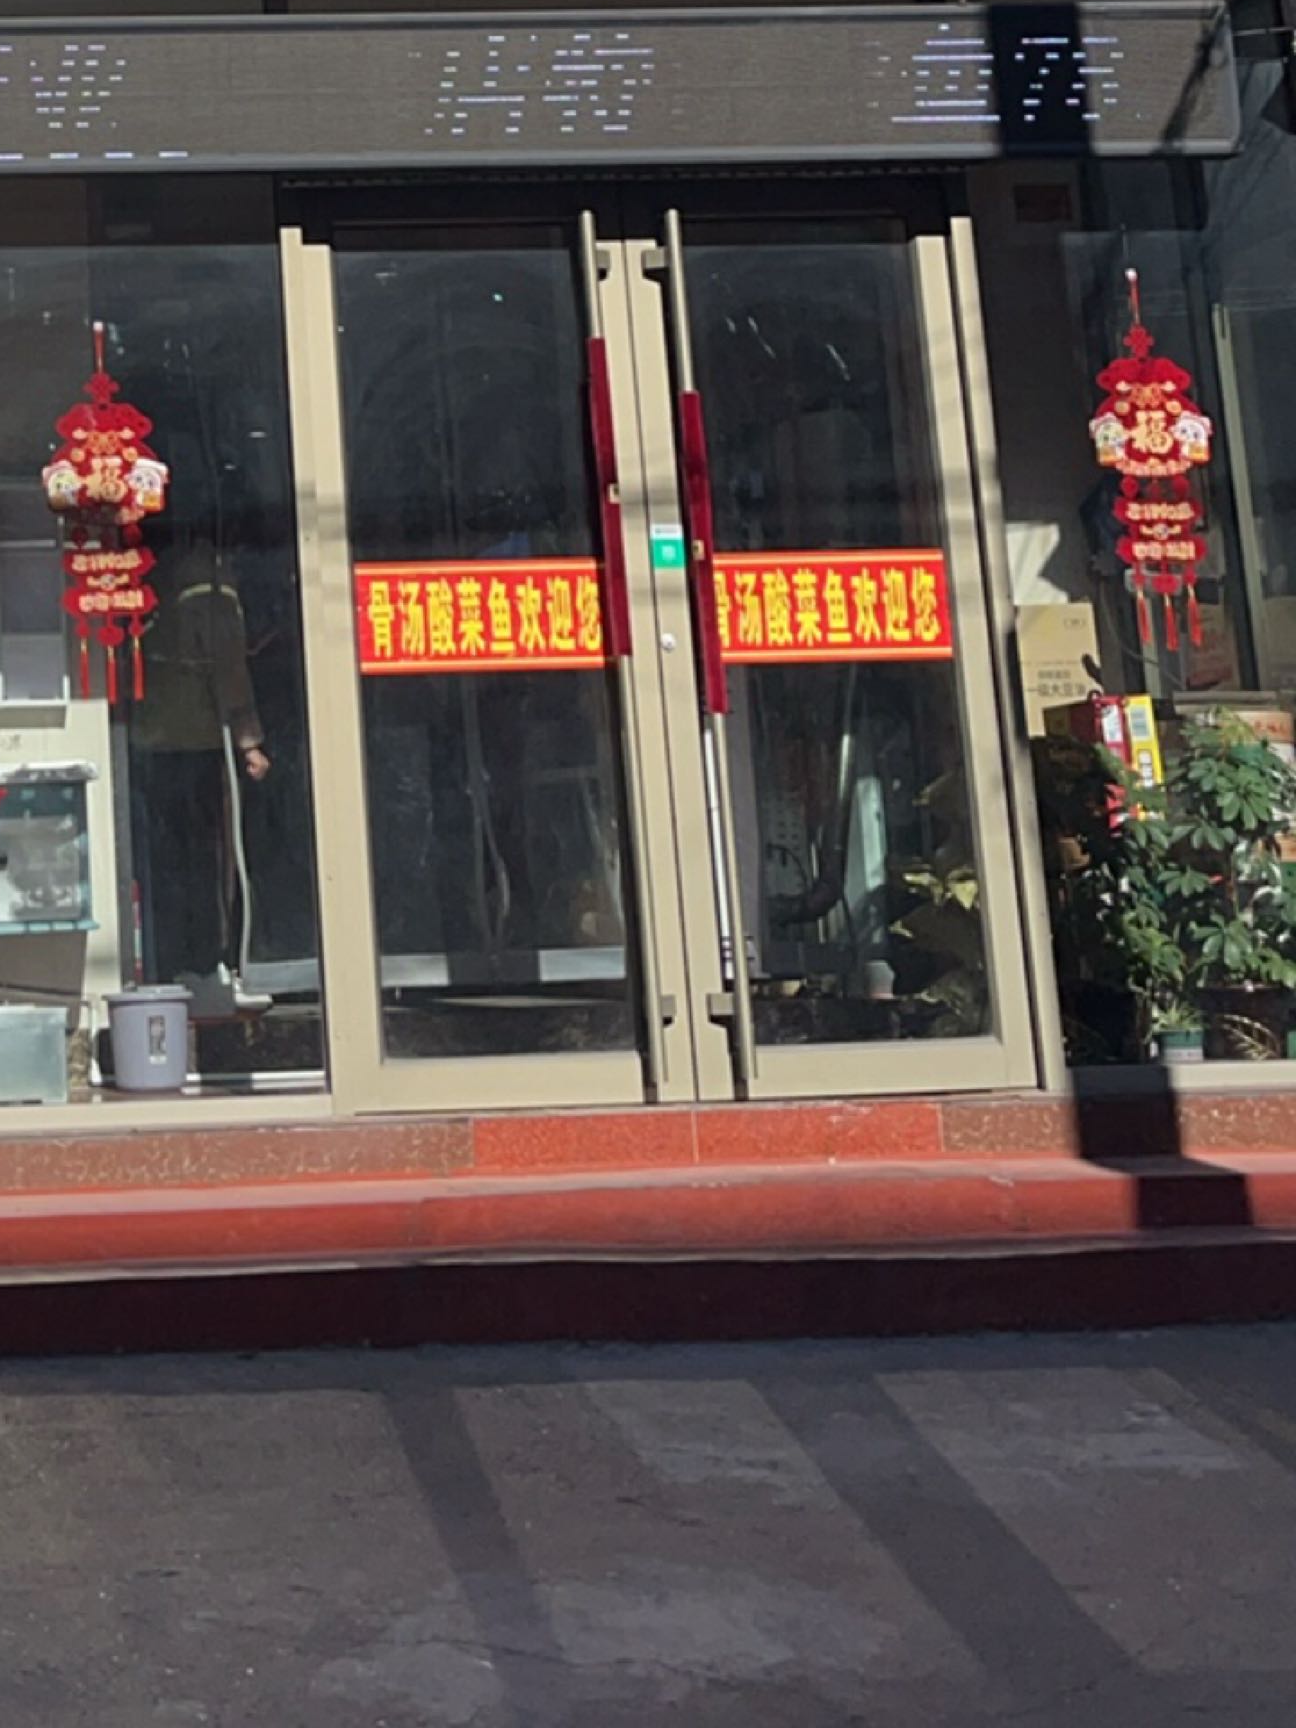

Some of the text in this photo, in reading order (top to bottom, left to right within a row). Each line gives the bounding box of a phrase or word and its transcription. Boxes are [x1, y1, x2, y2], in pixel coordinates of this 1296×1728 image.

[367, 575, 602, 658] 骨汤酸菜鱼欢迎您
